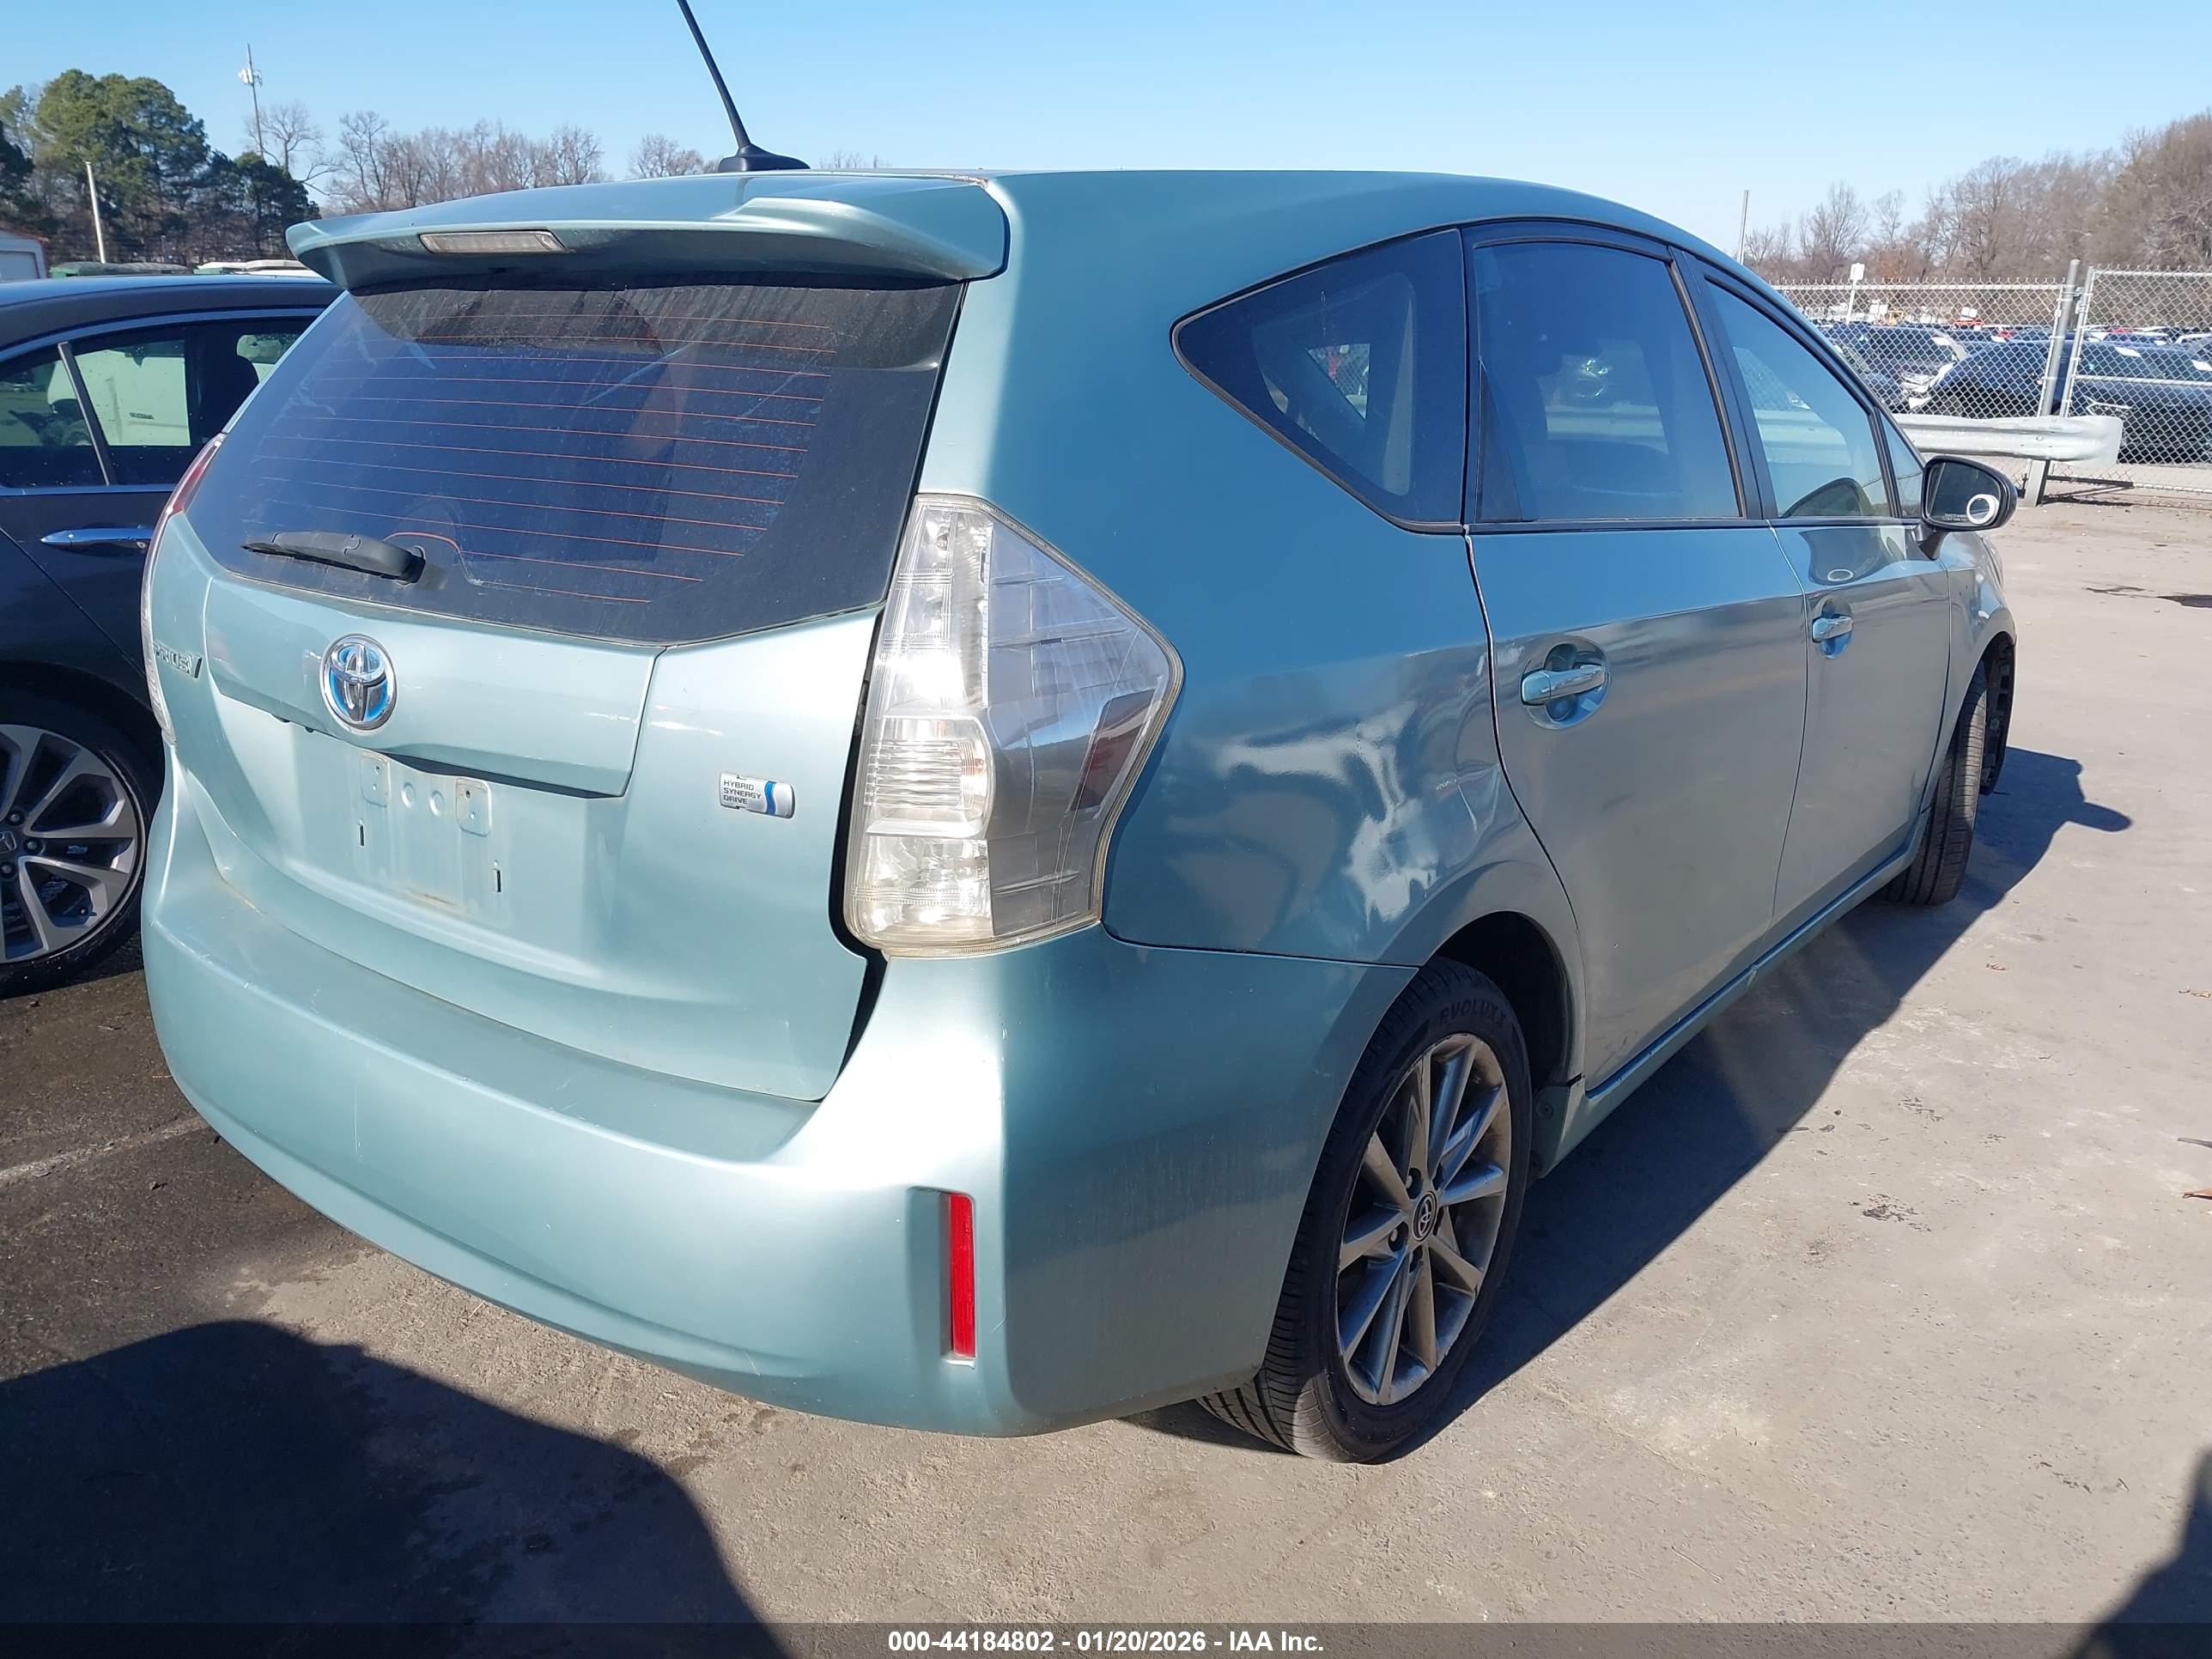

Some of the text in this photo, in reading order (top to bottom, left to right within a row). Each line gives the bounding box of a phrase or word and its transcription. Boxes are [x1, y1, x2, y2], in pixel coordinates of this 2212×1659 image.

[723, 779, 755, 791] HYBRID
[723, 787, 763, 799] SYNERGY
[723, 794, 749, 805] DRIVE
